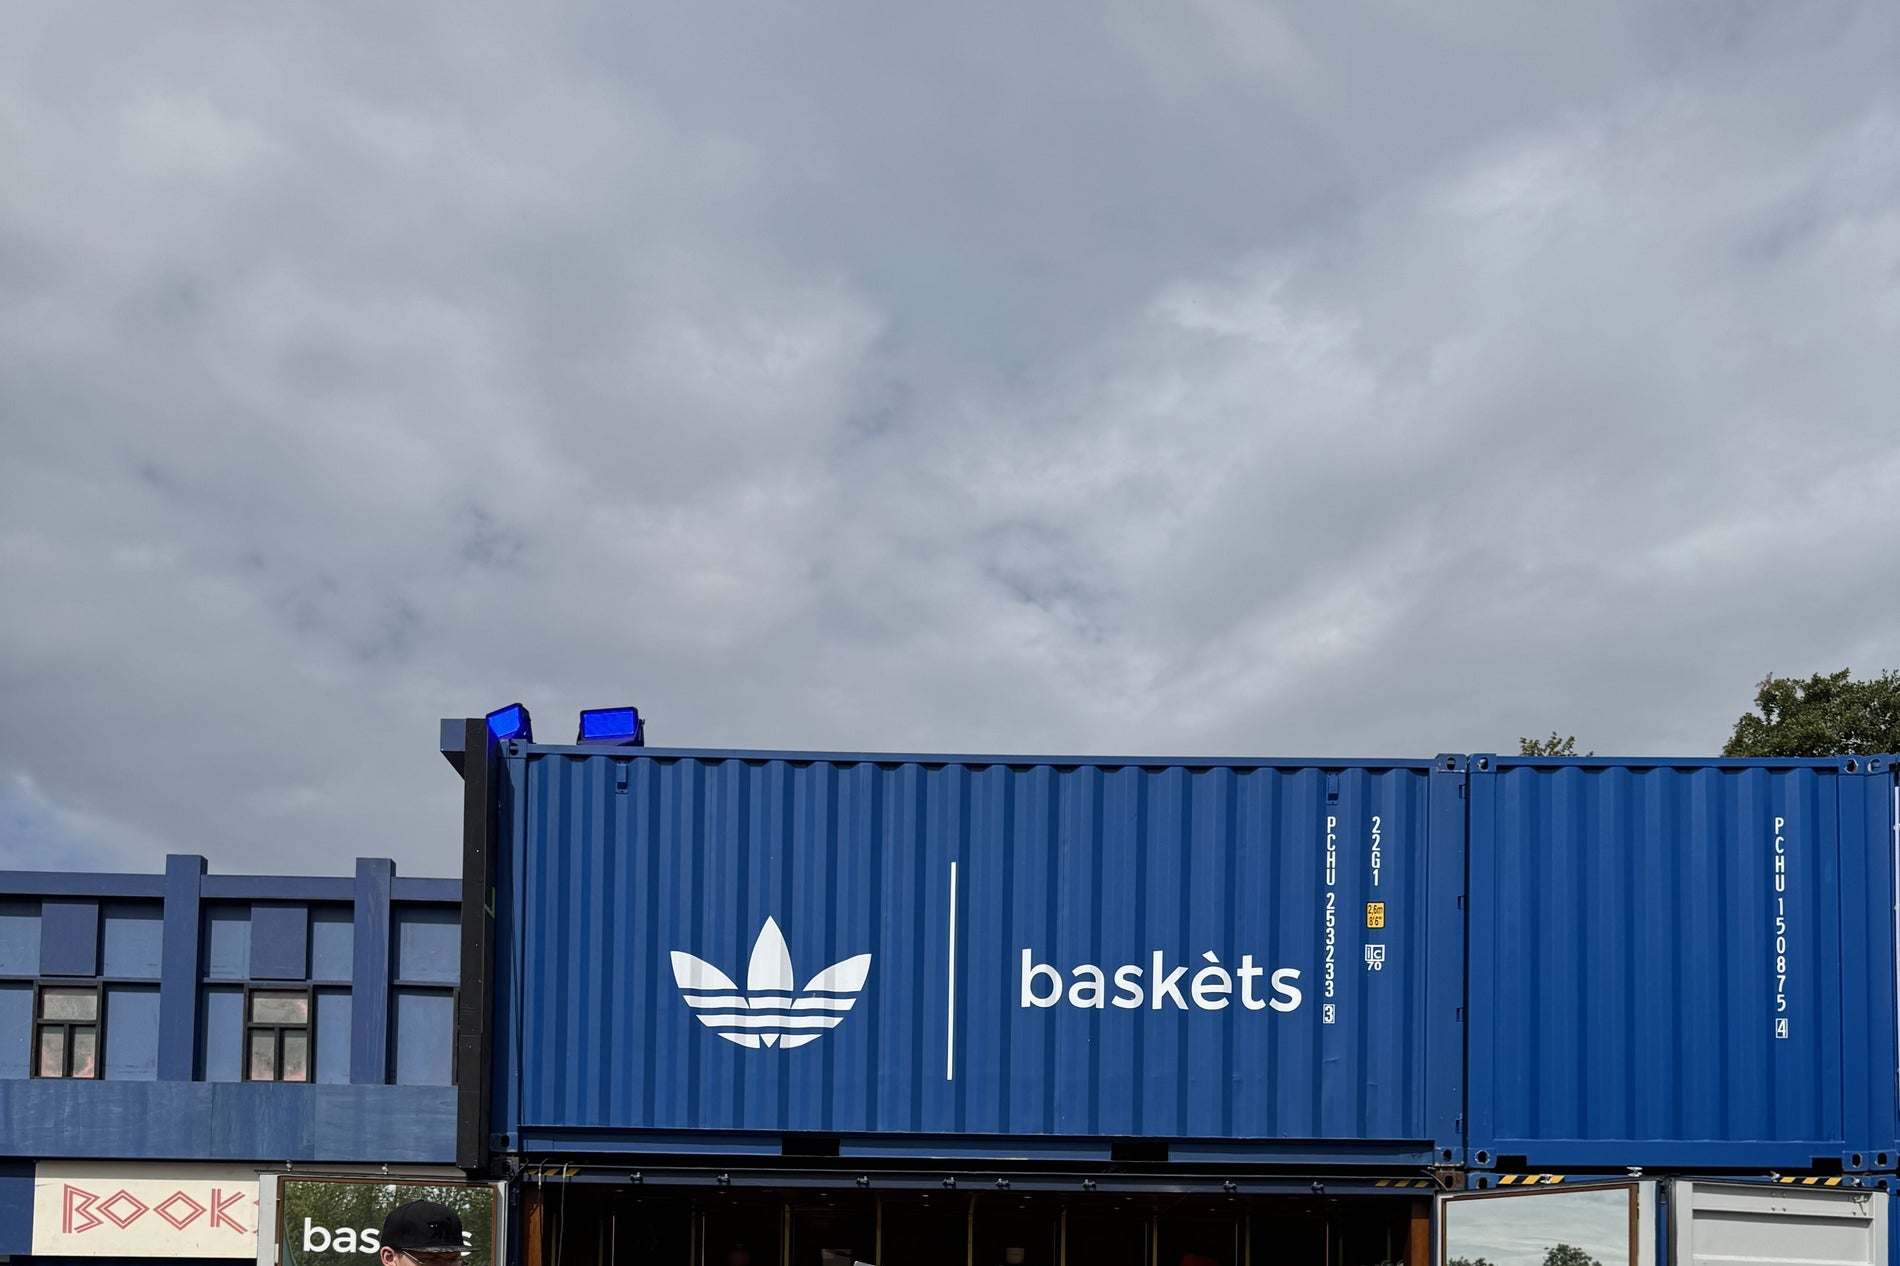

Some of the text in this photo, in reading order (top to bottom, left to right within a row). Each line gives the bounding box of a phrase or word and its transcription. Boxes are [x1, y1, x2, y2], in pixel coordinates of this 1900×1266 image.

[1371, 816, 1381, 886] 22G1
[1323, 816, 1336, 1023] PCHU 253233 3
[1774, 817, 1788, 1038] PCHU 150875 4
[1019, 948, 1303, 1013] baskèts
[1366, 961, 1382, 971] 70
[62, 1183, 260, 1236] BOOK
